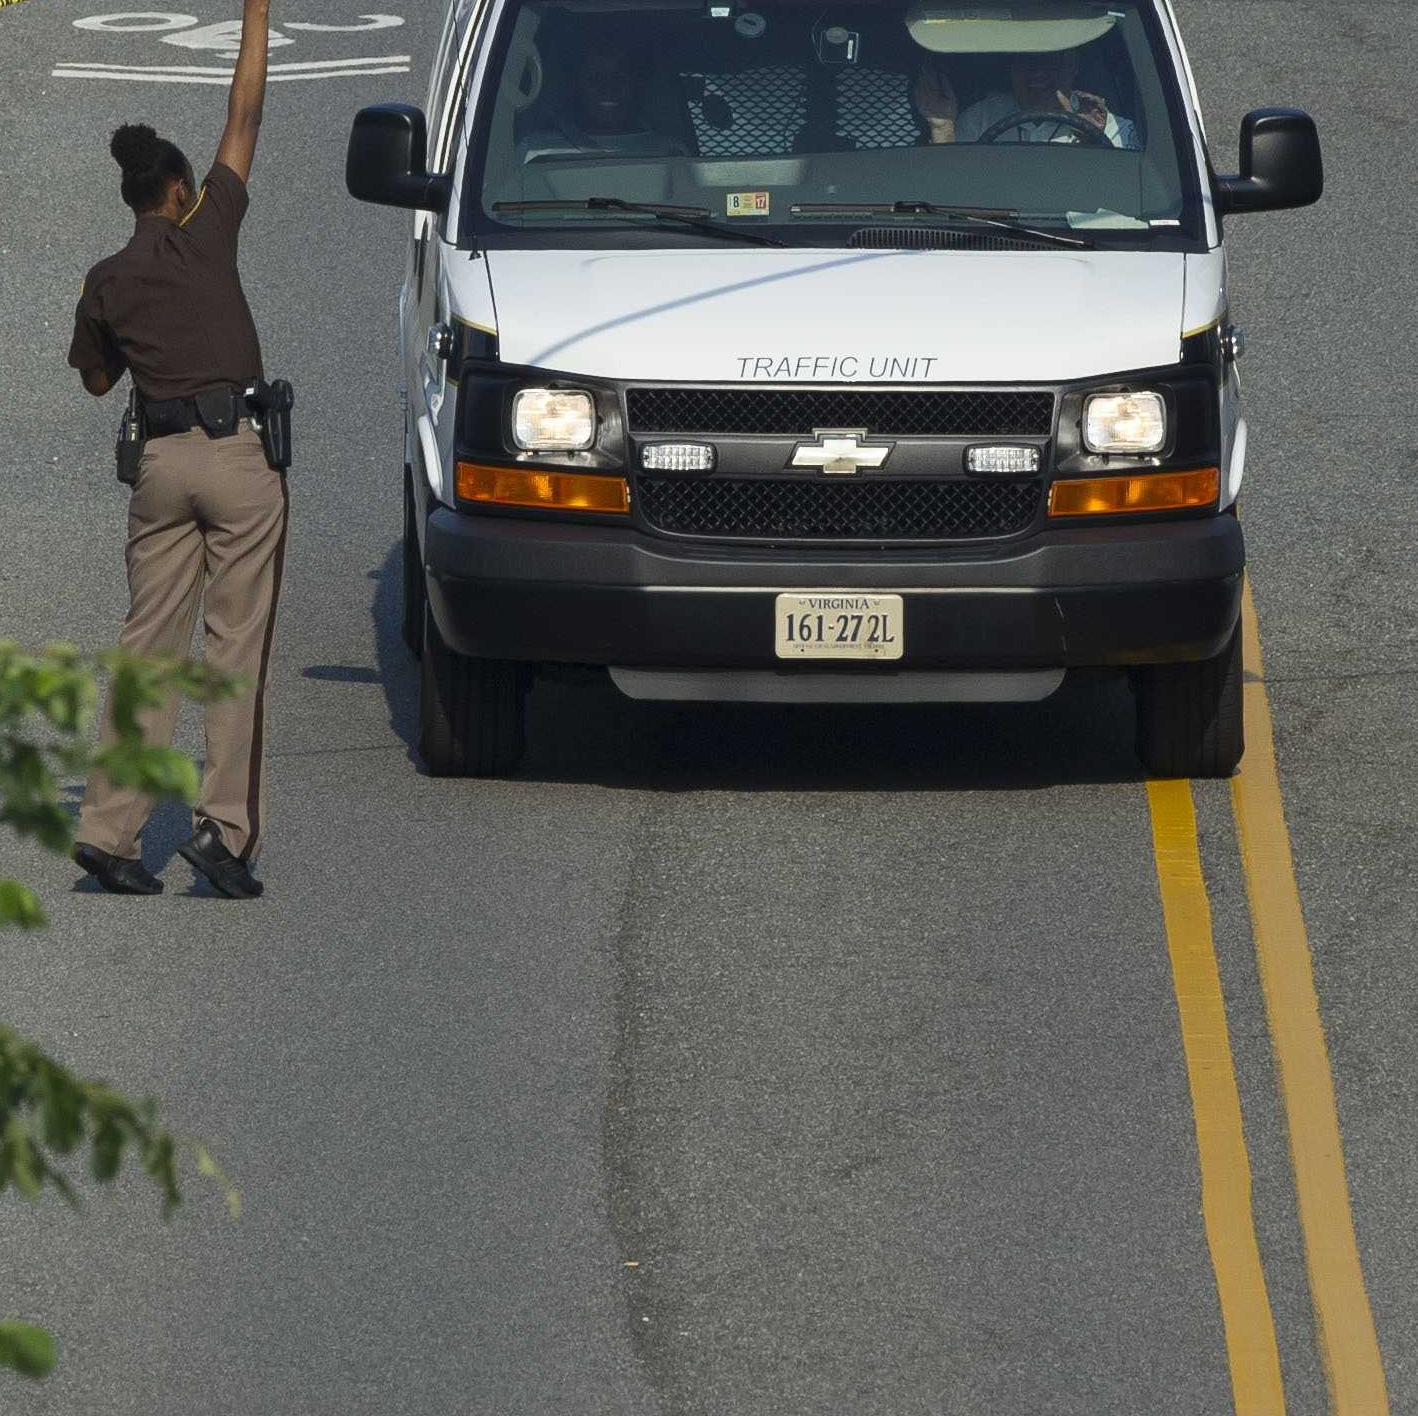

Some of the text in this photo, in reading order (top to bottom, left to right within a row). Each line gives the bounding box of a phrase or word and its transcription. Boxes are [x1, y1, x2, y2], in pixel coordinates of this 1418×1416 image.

[737, 356, 939, 378] TRAFFIC UNIT
[808, 599, 870, 610] VIRGINIA
[786, 613, 895, 643] 161-272L
